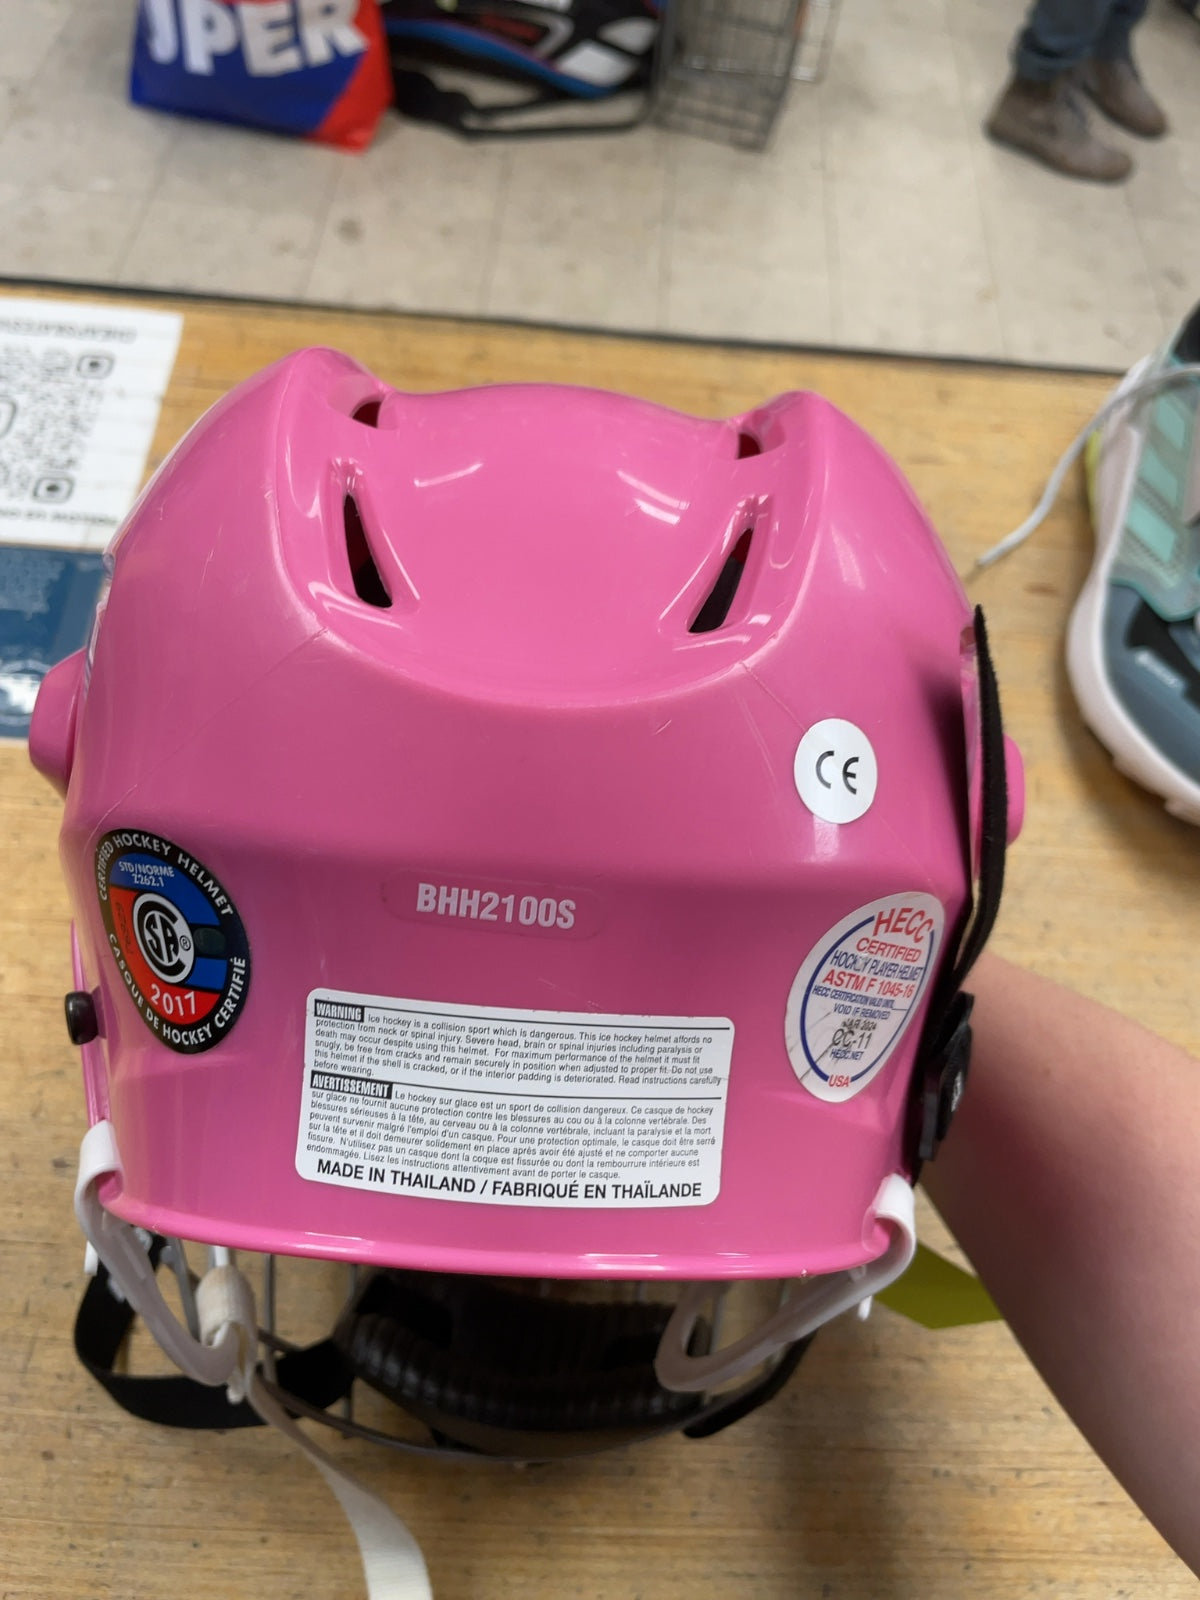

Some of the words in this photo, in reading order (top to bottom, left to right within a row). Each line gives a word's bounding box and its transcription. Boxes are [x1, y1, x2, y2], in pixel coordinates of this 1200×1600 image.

[816, 750, 859, 795] CE
[97, 841, 114, 901] CERTIFIED
[112, 833, 171, 856] HOCKEY
[178, 853, 233, 916] HELMET
[119, 861, 175, 877] STD/NORME
[416, 883, 576, 929] BHH2100S
[873, 907, 934, 943] HECC
[830, 950, 872, 972] HOCKY
[869, 959, 898, 978] PLAYER
[856, 937, 922, 963] CERTIFIED
[109, 934, 144, 1008] CASQUE
[146, 1009, 159, 1029] DE
[163, 1023, 212, 1046] HOCKEY
[215, 957, 246, 1028] CERTIFIÉ
[151, 983, 196, 1016] 2017
[822, 969, 866, 990] ASTM
[865, 978, 877, 992] F
[877, 980, 915, 998] 1045-16
[315, 1002, 362, 1021] WARNING
[368, 1014, 380, 1023] Ice
[383, 1016, 412, 1028] hockey
[414, 1019, 421, 1028] is
[431, 1022, 466, 1032] collision
[468, 1026, 490, 1036] sport
[493, 1027, 517, 1036] which
[520, 1028, 527, 1038] is
[530, 1030, 576, 1041] dangerous.
[579, 1031, 596, 1043] This
[599, 1033, 611, 1043] ice
[614, 1034, 642, 1044] hockey
[644, 1035, 671, 1043] helmet
[674, 1035, 700, 1044] affords
[834, 1003, 852, 1015] VOID
[852, 1007, 861, 1016] IF
[315, 1029, 338, 1038] death
[340, 1033, 356, 1042] may
[359, 1035, 381, 1044] occur
[383, 1038, 413, 1048] despite
[415, 1042, 438, 1053] using
[441, 1043, 456, 1053] this
[458, 1045, 489, 1056] helmet.
[495, 1048, 509, 1057] For
[511, 1051, 552, 1060] maximum
[554, 1053, 607, 1062] performance
[609, 1054, 618, 1063] of
[620, 1054, 633, 1063] the
[635, 1055, 662, 1063] helmet
[664, 1055, 670, 1064] it
[316, 1017, 355, 1030] protection
[358, 1023, 376, 1033] from
[378, 1027, 397, 1035] neck
[399, 1029, 408, 1037] or
[411, 1031, 436, 1040] spinal
[438, 1033, 462, 1044] injury.
[465, 1035, 495, 1045] Severe
[497, 1038, 521, 1048] head,
[524, 1040, 546, 1049] brain
[547, 1042, 557, 1050] or
[559, 1042, 584, 1052] spinal
[587, 1043, 616, 1053] injuries
[619, 1044, 655, 1055] including
[657, 1046, 692, 1055] paralysis
[314, 1059, 338, 1070] before
[341, 1065, 373, 1077] wearing.
[315, 1040, 341, 1050] snugly,
[344, 1042, 355, 1052] be
[357, 1044, 373, 1054] free
[375, 1046, 393, 1056] from
[395, 1051, 422, 1060] cracks
[425, 1054, 441, 1062] and
[443, 1056, 472, 1065] remain
[474, 1059, 510, 1070] securely
[512, 1060, 521, 1069] in
[523, 1062, 556, 1071] position
[559, 1063, 581, 1072] when
[584, 1064, 619, 1074] adjusted
[621, 1065, 629, 1074] to
[631, 1066, 657, 1075] proper
[659, 1066, 668, 1074] fit.
[671, 1066, 683, 1074] Do
[315, 1049, 328, 1058] this
[330, 1049, 357, 1062] helmet
[359, 1054, 365, 1063] if
[367, 1056, 380, 1065] the
[382, 1058, 401, 1068] shell
[403, 1060, 410, 1070] is
[413, 1063, 447, 1074] cracked,
[450, 1067, 460, 1075] or
[461, 1067, 467, 1075] if
[469, 1068, 483, 1077] the
[485, 1070, 515, 1079] interior
[518, 1072, 552, 1083] padding
[554, 1073, 561, 1082] is
[564, 1074, 615, 1083] deteriorated.
[618, 1075, 640, 1084] Read
[642, 1076, 687, 1084] instructions
[689, 1076, 722, 1085] carefully
[312, 1074, 390, 1098] AVERTISSEMENT
[395, 1090, 405, 1100] Le
[408, 1093, 437, 1105] hockey
[439, 1097, 453, 1106] sur
[455, 1098, 478, 1108] glace
[480, 1101, 493, 1109] est
[509, 1104, 531, 1113] sport
[533, 1104, 544, 1112] de
[547, 1105, 581, 1113] collision
[583, 1106, 628, 1116] dangereux.
[631, 1106, 642, 1114] Ce
[675, 1106, 685, 1114] de
[687, 1106, 713, 1116] hockey
[828, 1074, 850, 1087] USA
[307, 1144, 360, 1159] endommagée.
[363, 1152, 385, 1163] Lisez
[387, 1155, 399, 1165] les
[402, 1157, 449, 1170] instructions
[453, 1164, 510, 1175] attentivement
[512, 1169, 535, 1177] avant
[538, 1169, 549, 1178] de
[551, 1170, 576, 1180] porter
[579, 1170, 587, 1179] le
[589, 1172, 620, 1180] casque.
[318, 1159, 364, 1179] MADE
[369, 1167, 385, 1183] IN
[391, 1171, 475, 1192] THAILAND
[480, 1179, 488, 1195] /
[493, 1181, 578, 1198] FABRIQUÉ
[584, 1184, 606, 1199] EN
[613, 1181, 701, 1198] THAÏLANDE
